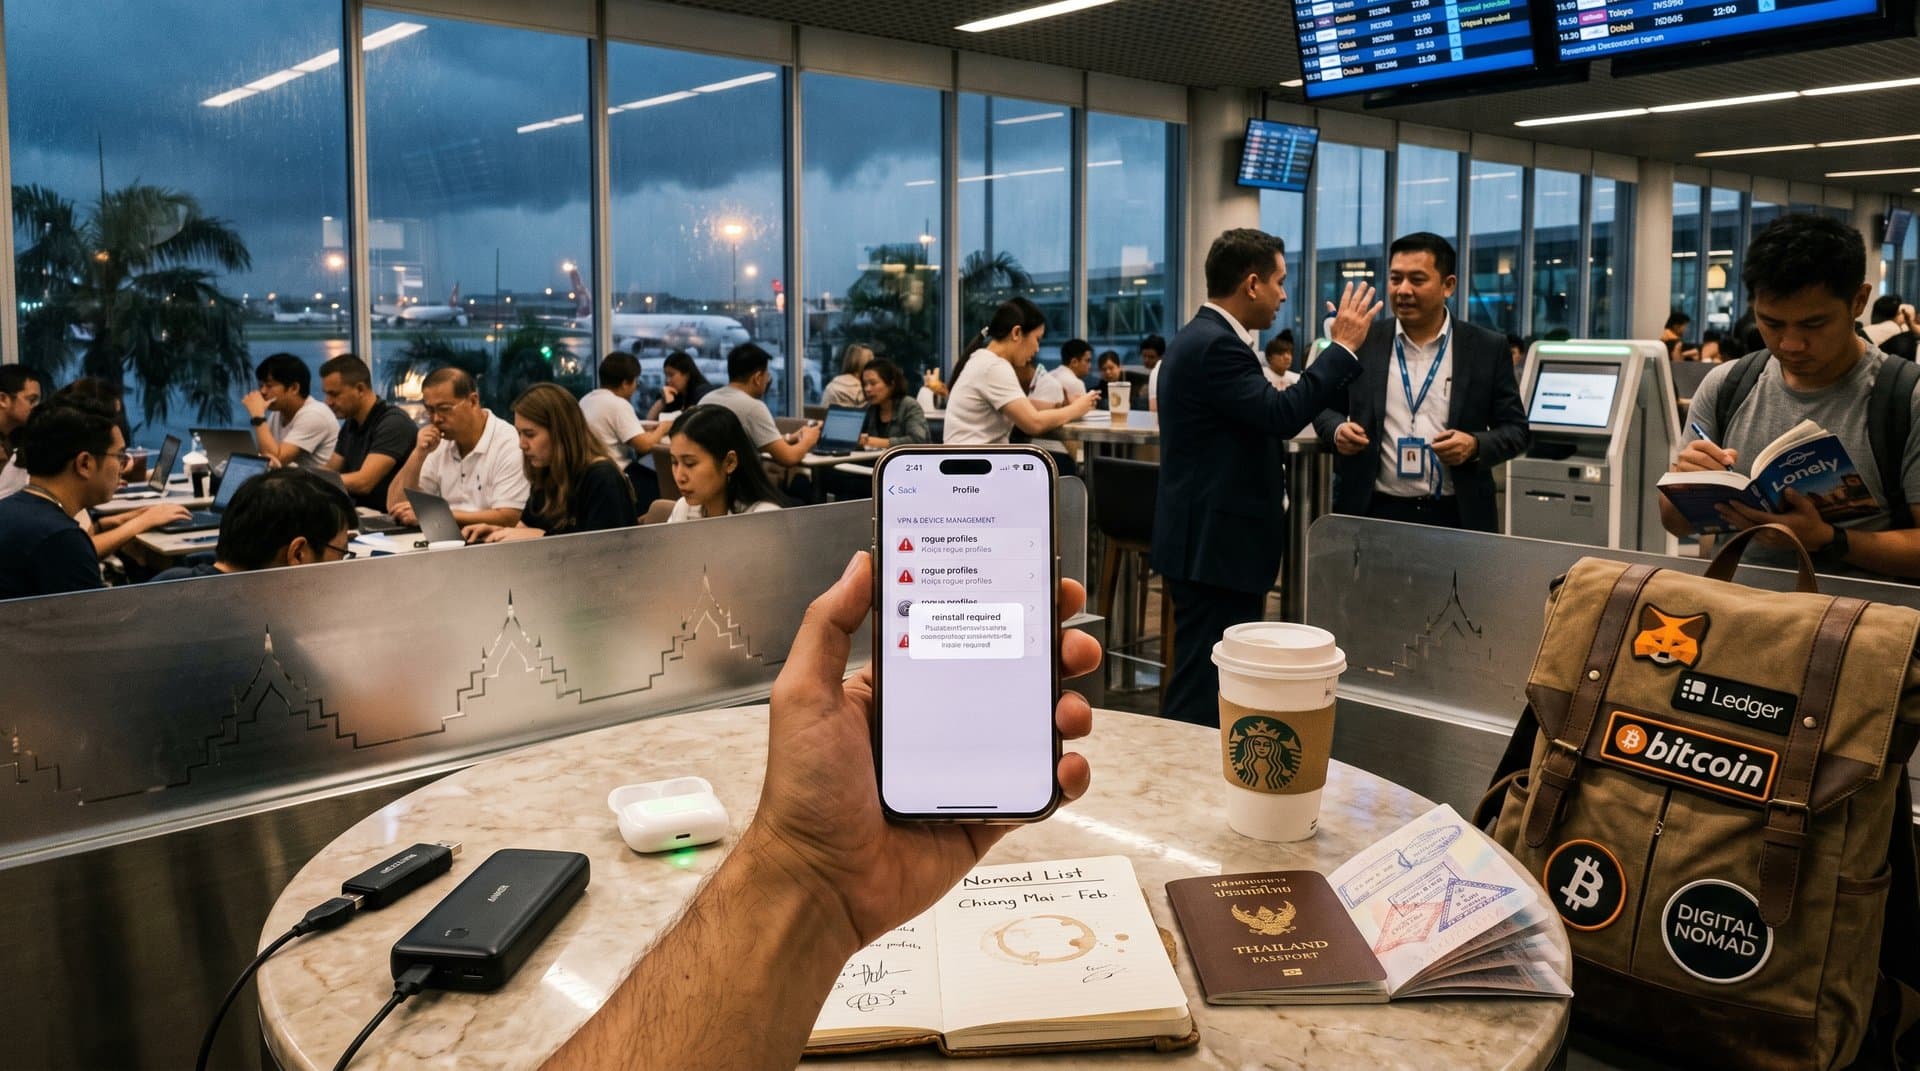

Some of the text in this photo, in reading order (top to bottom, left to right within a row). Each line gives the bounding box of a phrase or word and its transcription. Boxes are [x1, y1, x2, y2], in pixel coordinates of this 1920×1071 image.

[1772, 459, 1838, 492] Lonely
[947, 535, 978, 544] profiles
[965, 546, 992, 554] profiles
[947, 567, 978, 576] profiles
[966, 613, 1001, 622] required
[1712, 686, 1784, 719] Ledger
[1645, 732, 1763, 788] bitcoin
[963, 868, 1083, 887] Nomad List
[958, 898, 1017, 910] Chiang
[1024, 893, 1054, 903] Mai
[1678, 903, 1759, 940] DIGITAL
[1233, 940, 1328, 955] THAILAND
[1674, 922, 1756, 957] NOMAD
[1252, 952, 1319, 964] PASSPORT
